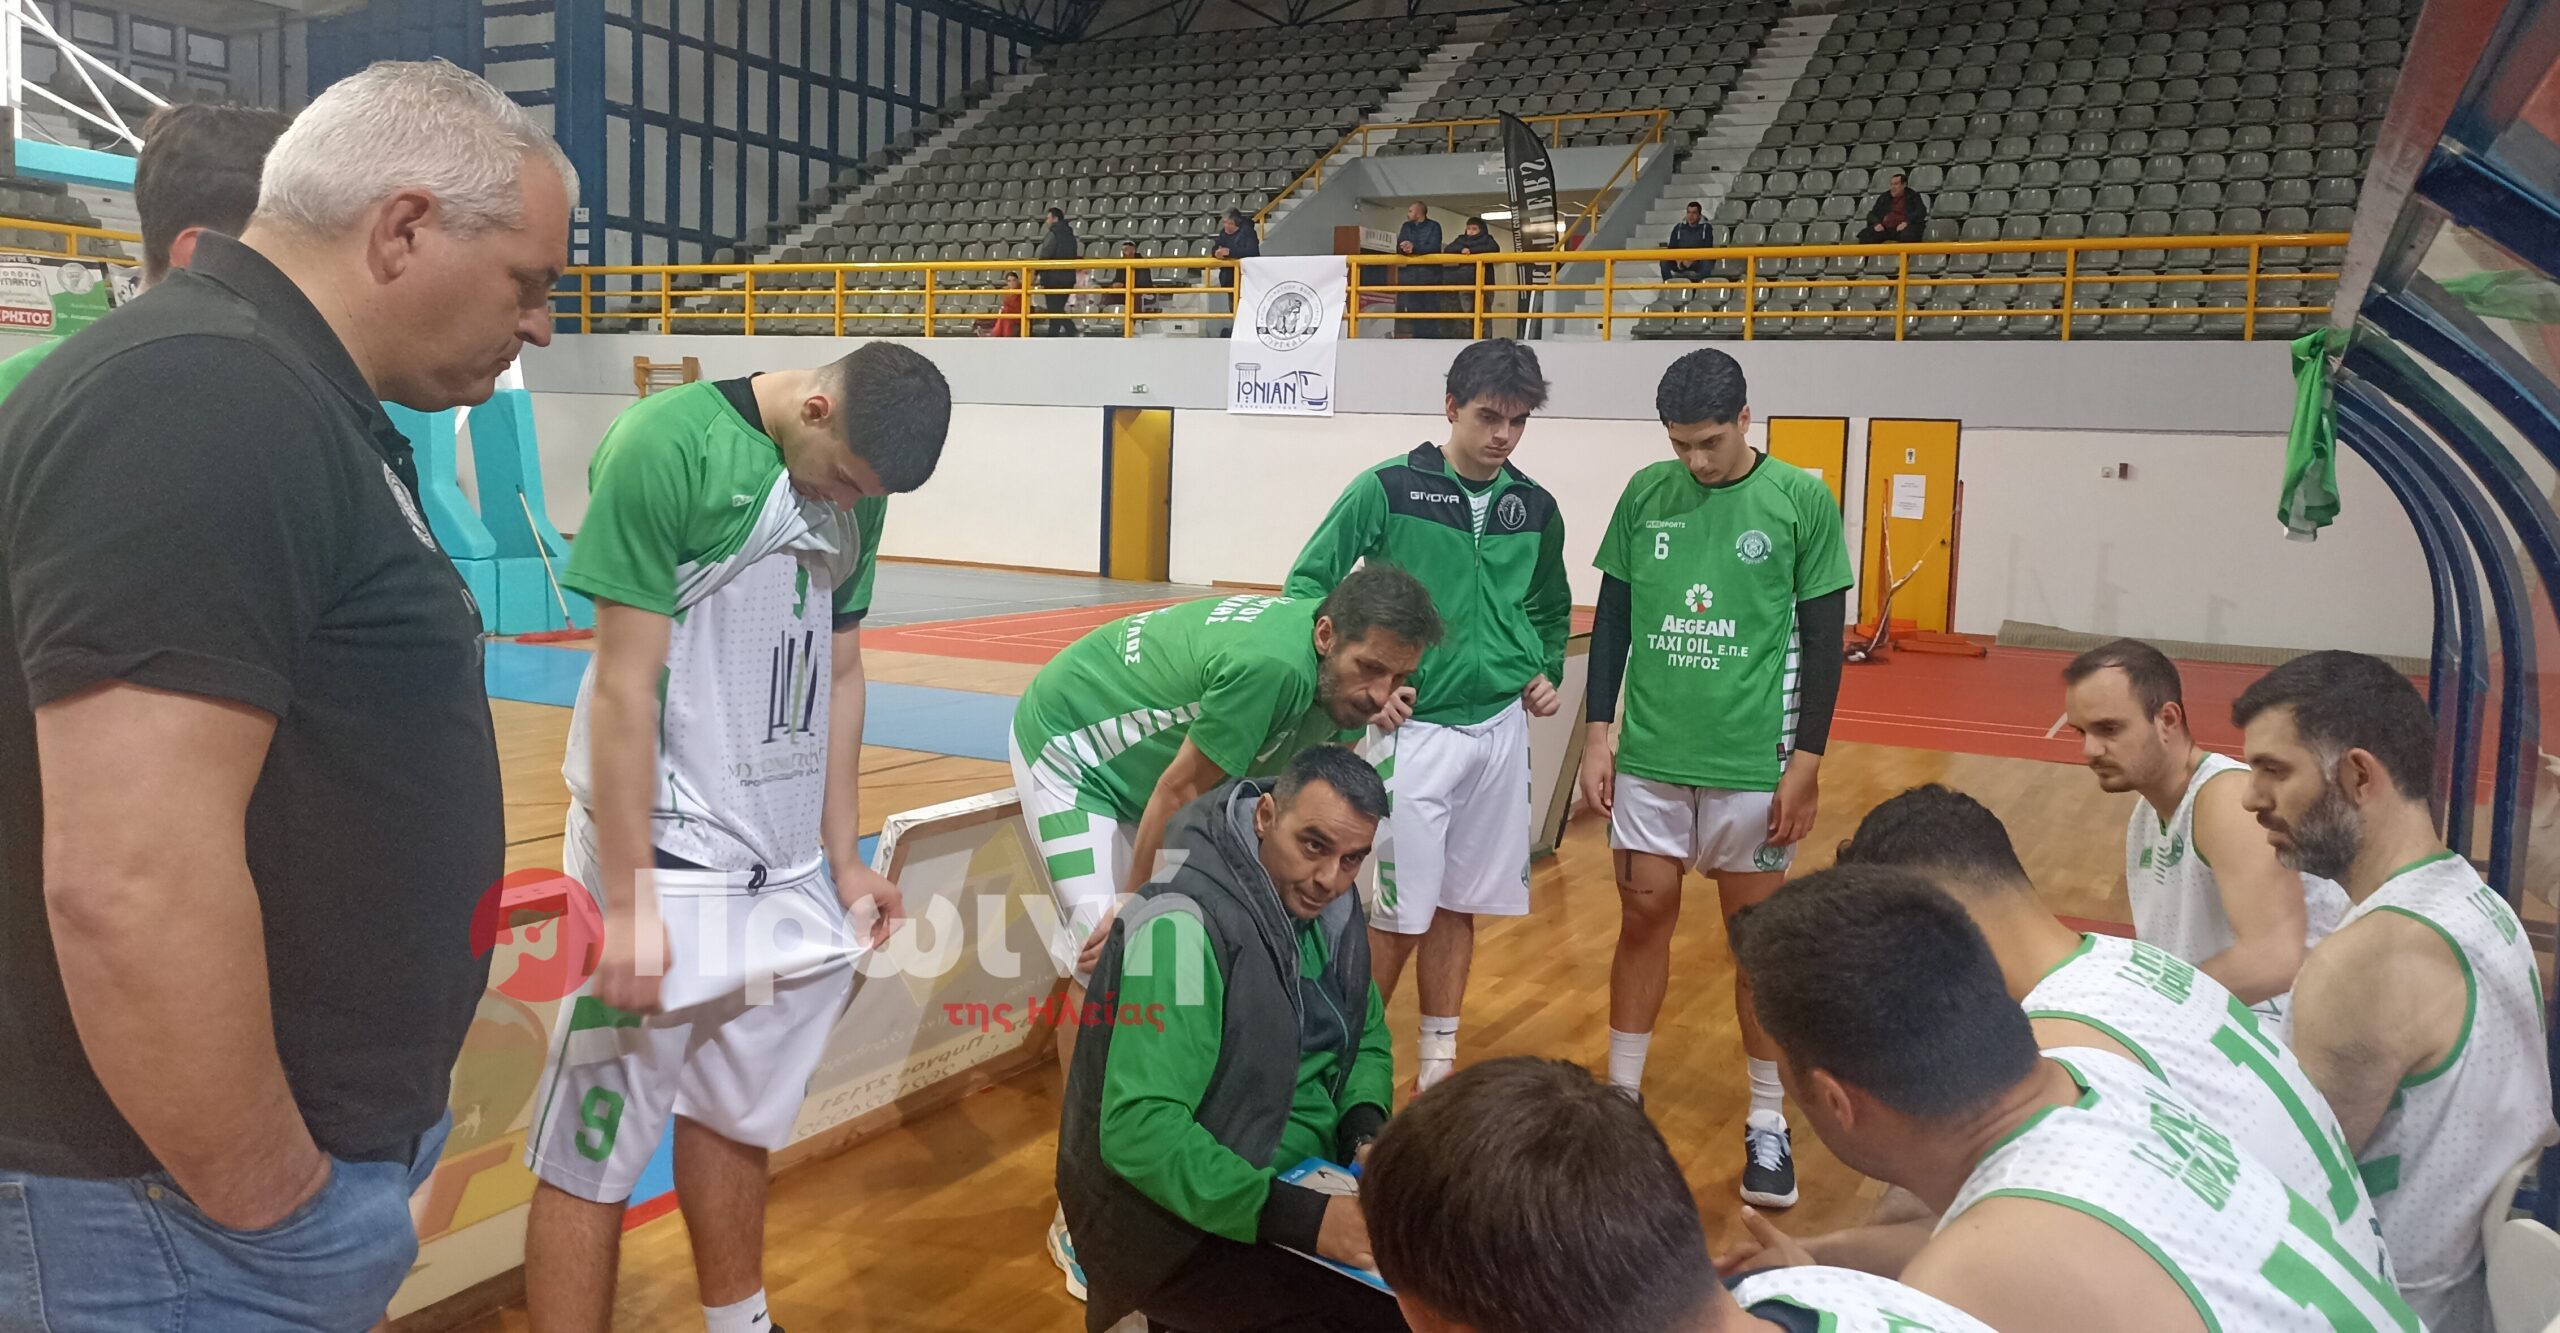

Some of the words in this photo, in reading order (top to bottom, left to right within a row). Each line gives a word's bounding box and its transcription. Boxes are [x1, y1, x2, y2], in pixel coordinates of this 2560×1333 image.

[0, 310, 50, 325] ΡΗΣΤΟΣ
[1237, 380, 1296, 405] IONIAN
[1410, 491, 1460, 504] GIVOVA
[1654, 532, 1670, 560] 6
[1661, 615, 1736, 638] AEGEAN
[1647, 634, 1682, 652] TAXI
[1686, 638, 1713, 655] OIL
[1667, 653, 1721, 671] ΠΥΡΓΟΣ
[575, 1085, 628, 1163] 9
